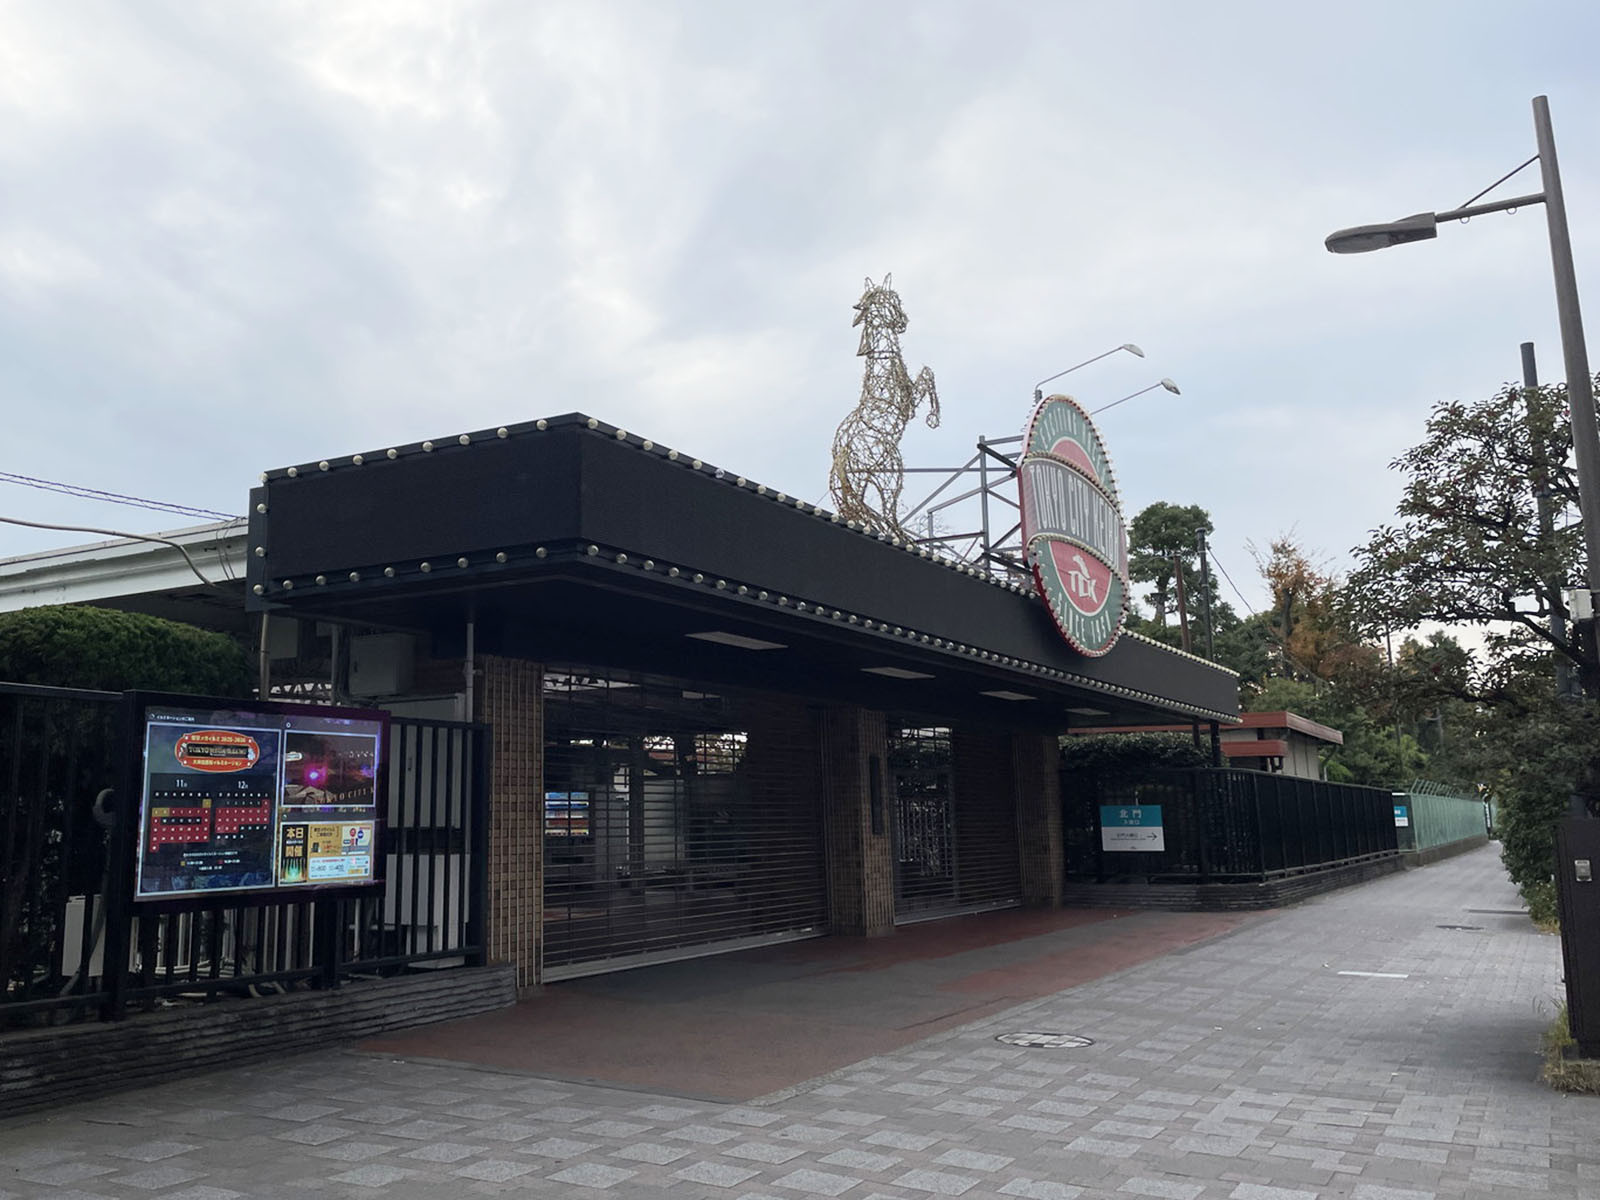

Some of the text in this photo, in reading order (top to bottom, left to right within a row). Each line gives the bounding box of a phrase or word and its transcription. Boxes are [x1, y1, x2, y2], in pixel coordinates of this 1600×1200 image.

[1029, 464, 1119, 571] TOKYO CITY KEIBA
[1068, 570, 1098, 604] TCK
[1056, 591, 1086, 642] SINCE
[1119, 809, 1141, 819] 北門
[286, 827, 304, 839] 本日
